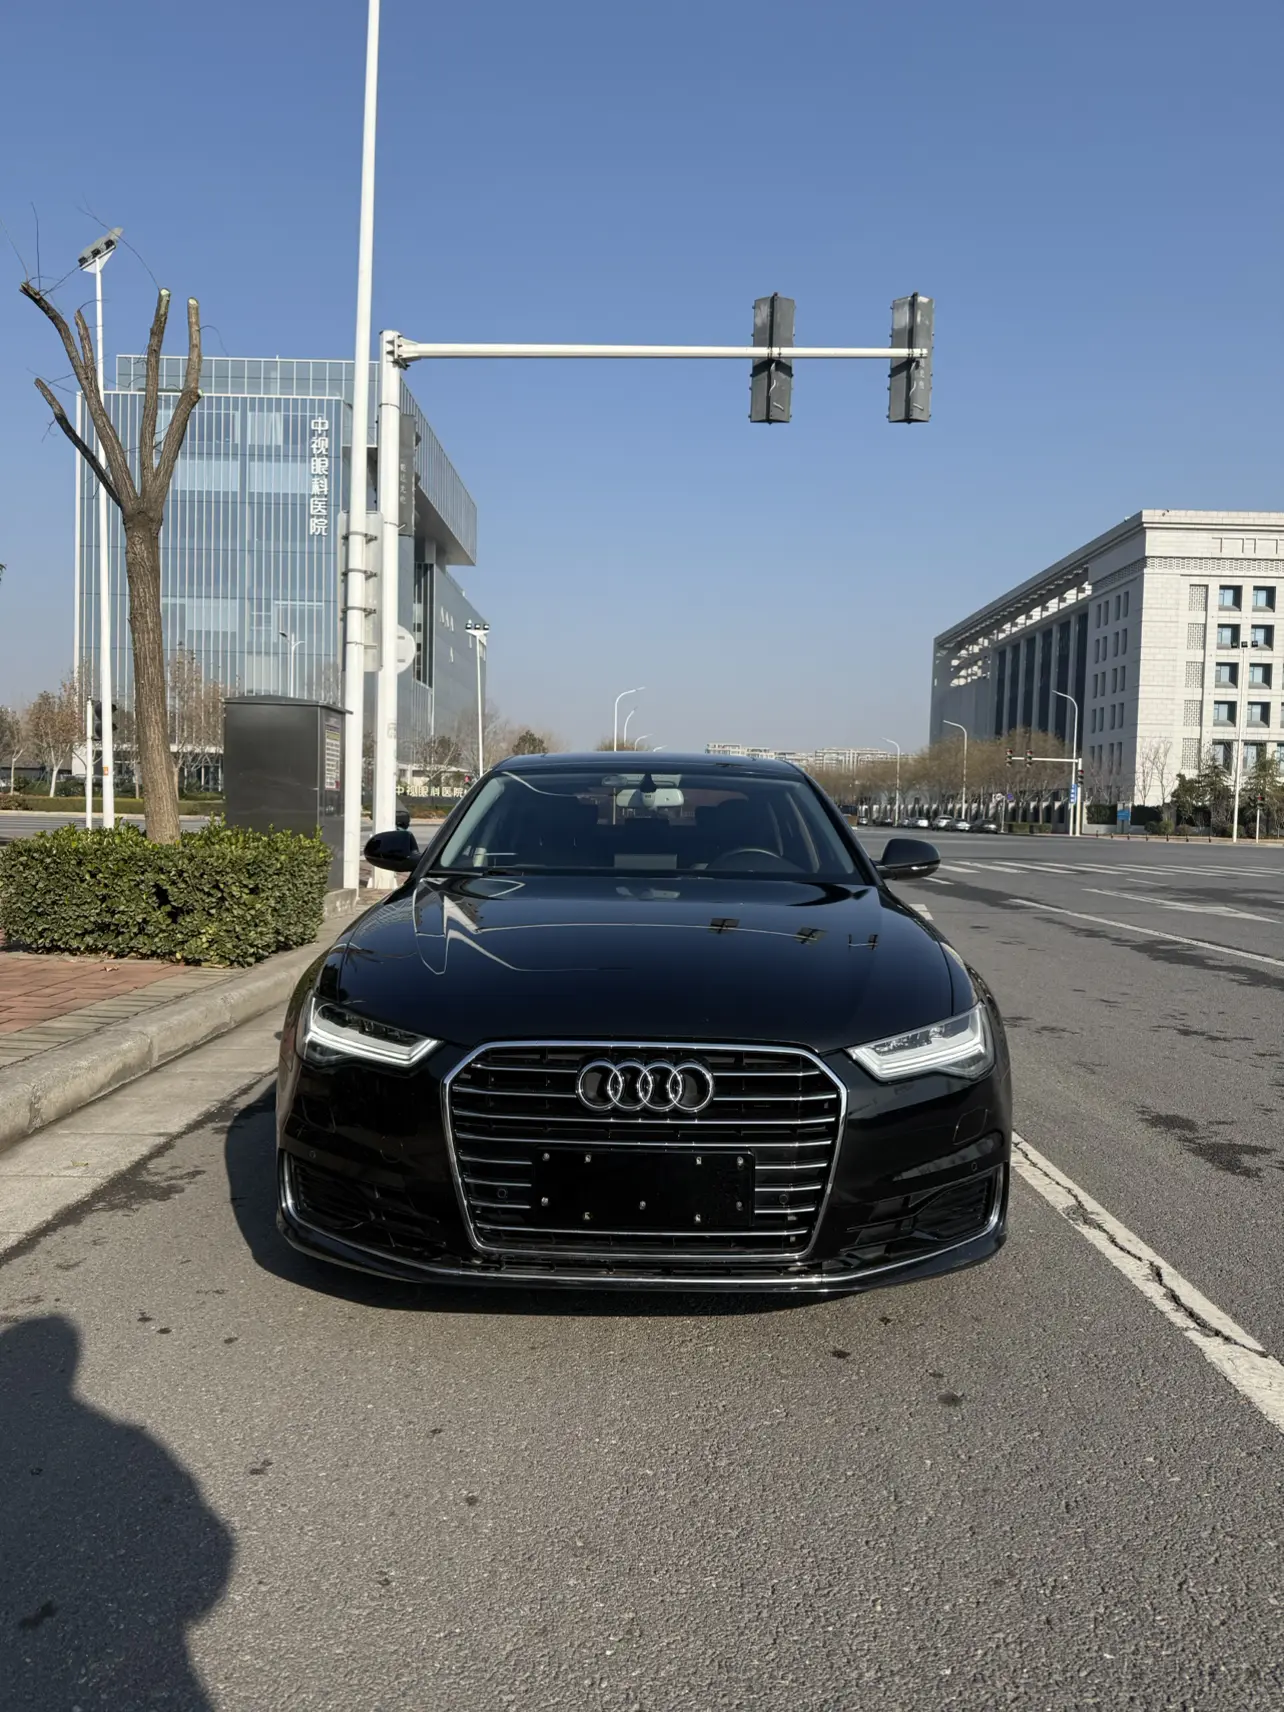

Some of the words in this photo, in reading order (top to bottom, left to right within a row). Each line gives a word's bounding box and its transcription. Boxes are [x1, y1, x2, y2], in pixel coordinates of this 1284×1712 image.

[309, 416, 329, 536] 中视眼科医院
[396, 785, 468, 798] 中视眼科医院
